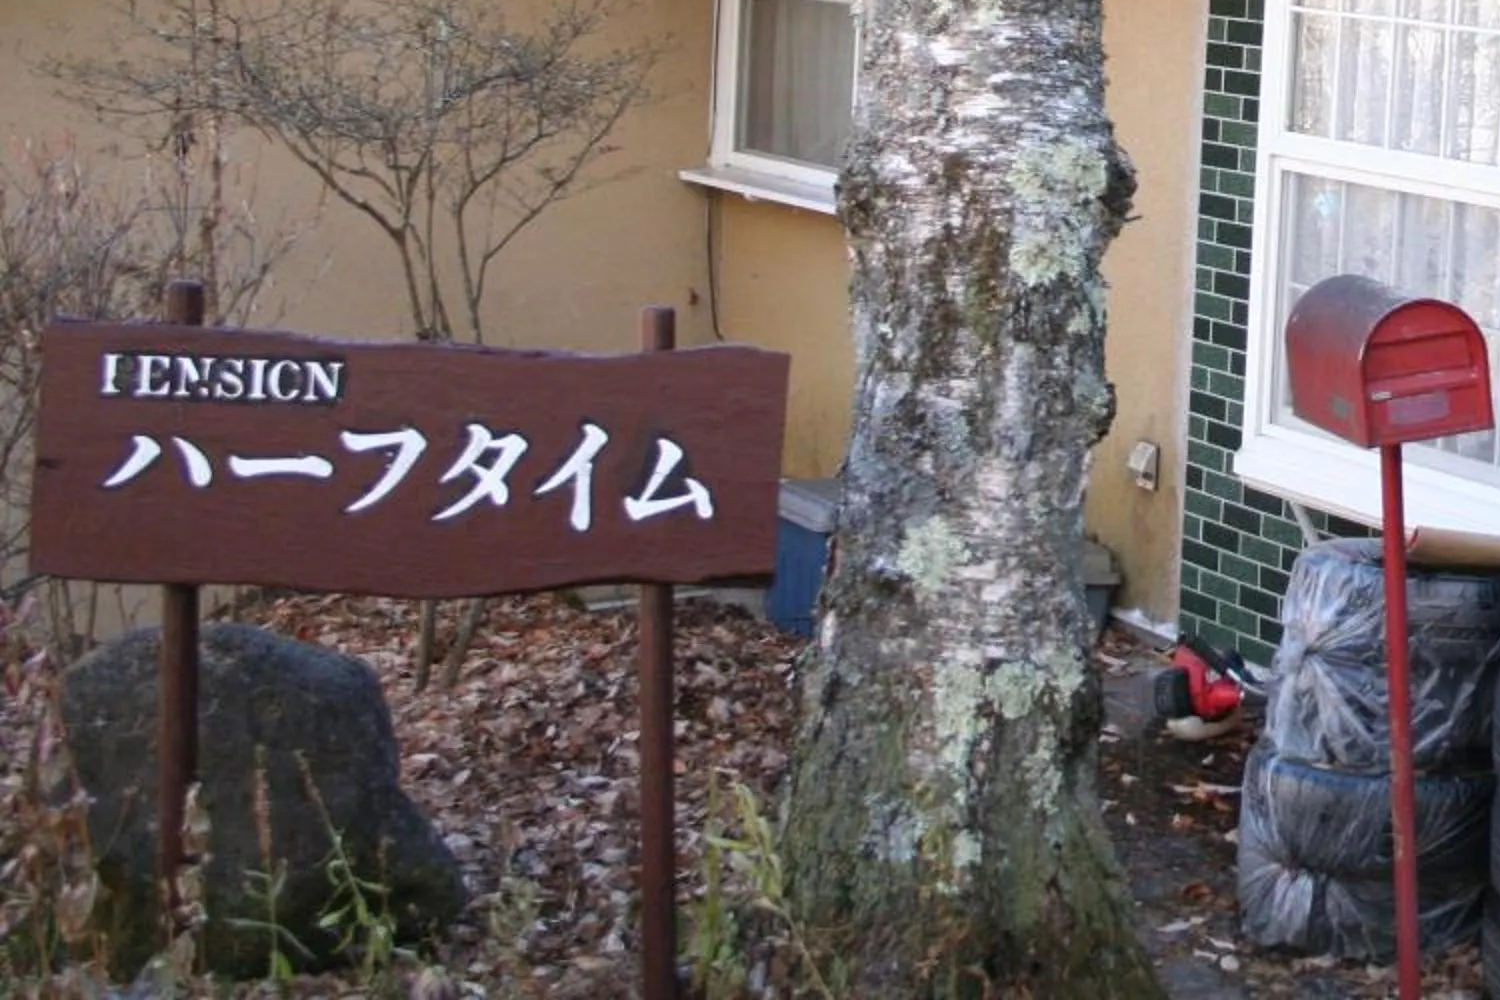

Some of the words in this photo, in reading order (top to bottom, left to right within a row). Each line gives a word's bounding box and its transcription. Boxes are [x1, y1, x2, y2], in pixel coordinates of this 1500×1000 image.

[102, 422, 715, 532] ハーフタイム
